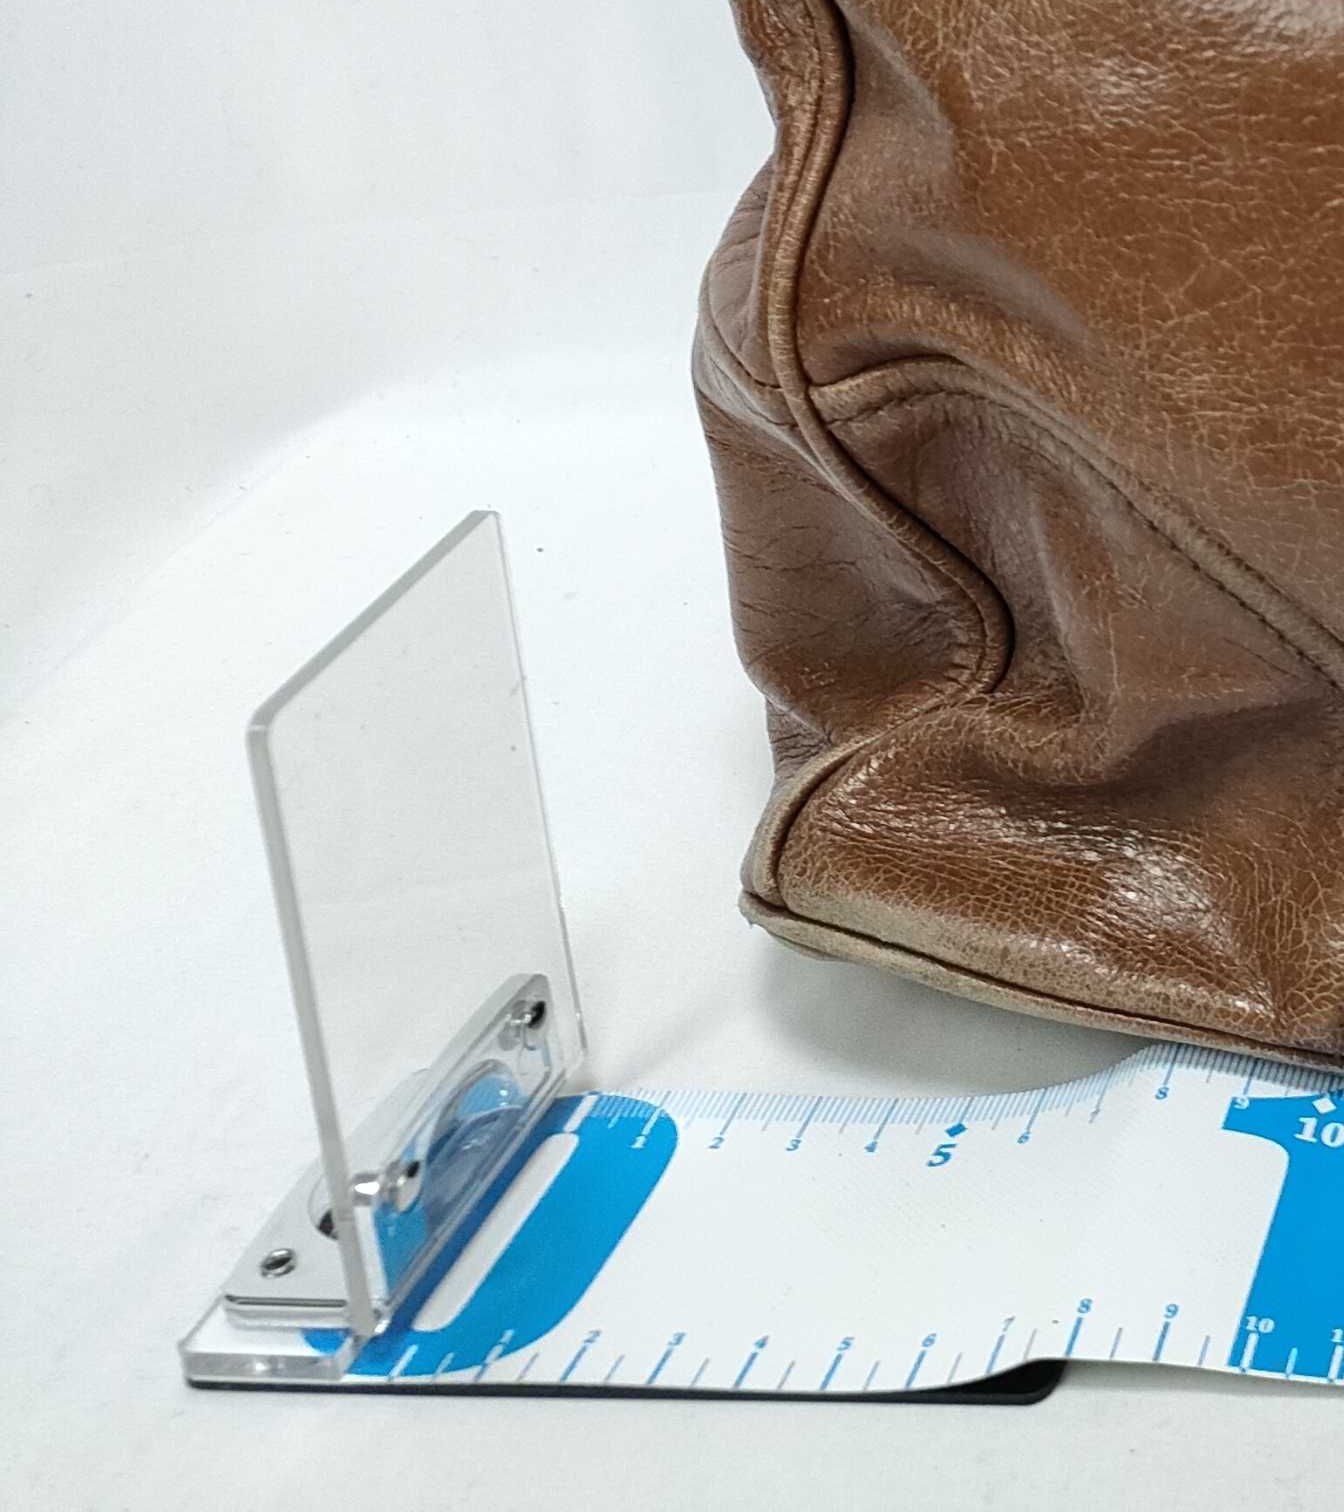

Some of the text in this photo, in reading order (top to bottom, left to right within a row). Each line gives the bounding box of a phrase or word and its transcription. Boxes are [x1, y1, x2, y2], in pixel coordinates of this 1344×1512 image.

[631, 1135, 646, 1149] 1
[708, 1137, 724, 1149] 2
[786, 1139, 801, 1152] 3
[927, 1144, 956, 1166] 5
[1234, 1095, 1250, 1110] 9
[836, 1336, 855, 1351] 5
[921, 1332, 937, 1348] 6
[1077, 1297, 1093, 1314] 8
[1164, 1303, 1180, 1319] 9
[1245, 1315, 1276, 1334] 10
